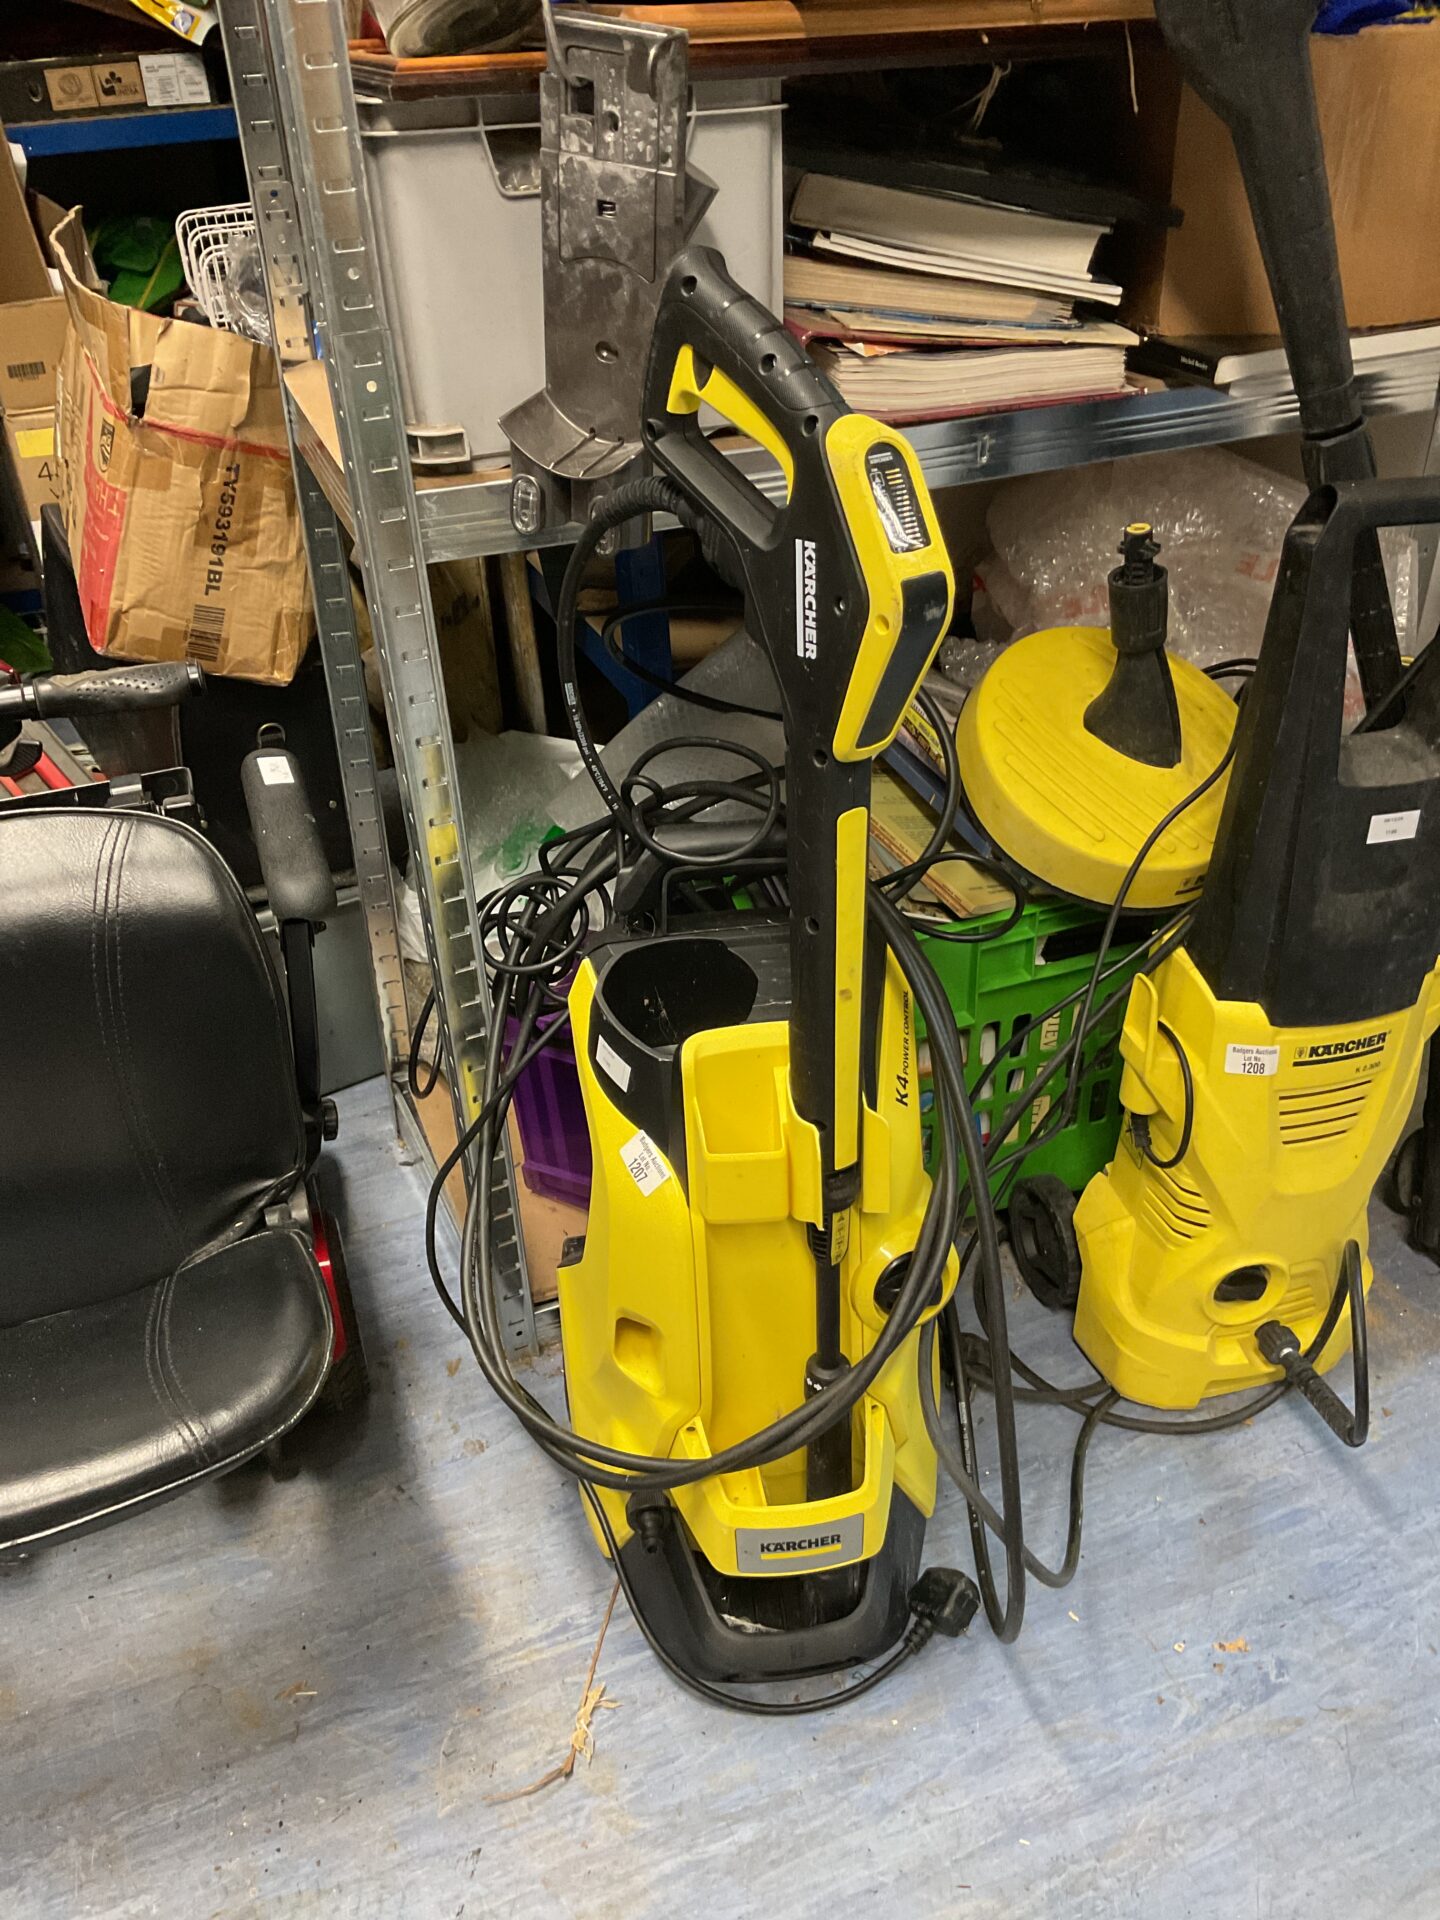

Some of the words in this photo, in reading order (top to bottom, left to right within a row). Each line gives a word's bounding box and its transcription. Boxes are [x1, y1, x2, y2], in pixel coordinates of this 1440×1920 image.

[204, 463, 241, 596] TY593191BL
[803, 540, 817, 660] KÄRCHER
[1232, 1046, 1254, 1055] Badgers
[1241, 1062, 1265, 1074] 1208
[640, 1135, 653, 1158] Badgers
[628, 1157, 648, 1183] 1207
[760, 1534, 841, 1553] KÄRCHER
